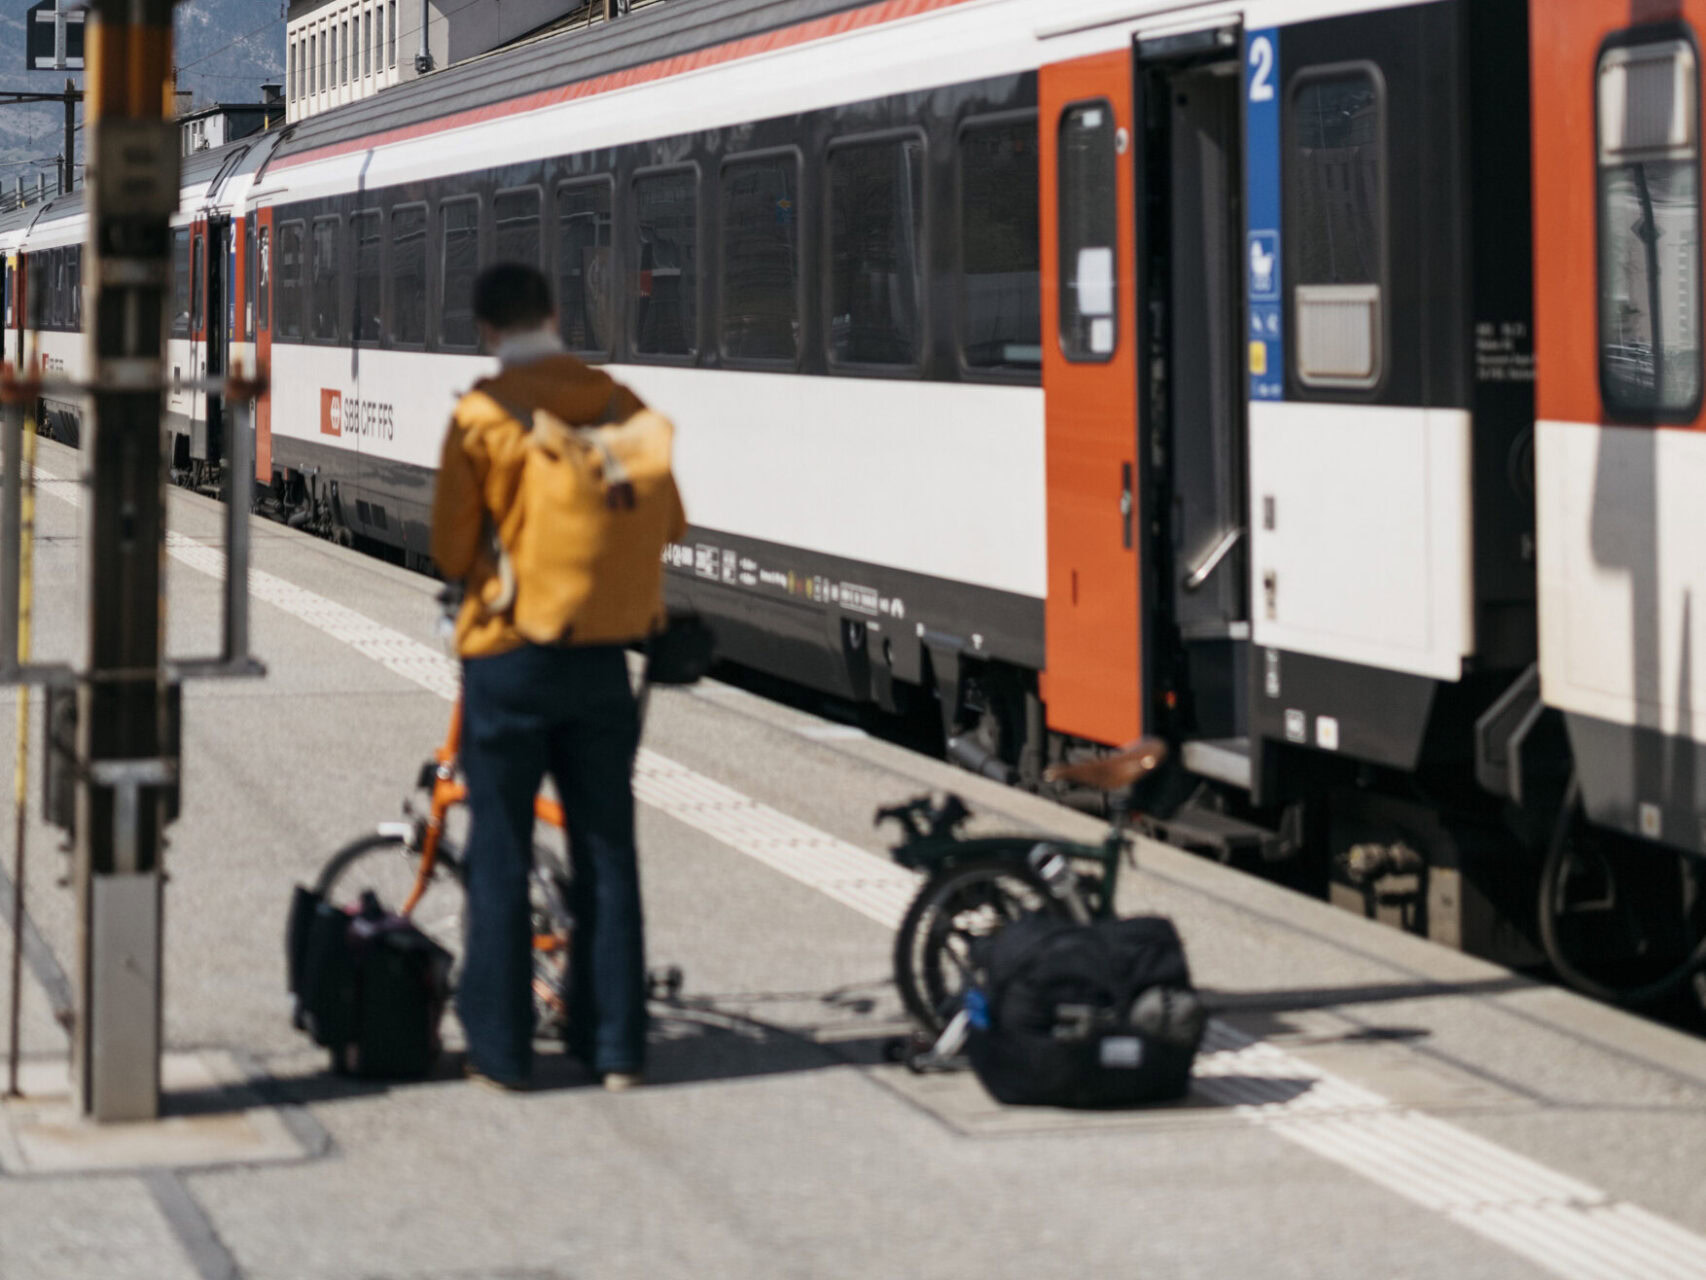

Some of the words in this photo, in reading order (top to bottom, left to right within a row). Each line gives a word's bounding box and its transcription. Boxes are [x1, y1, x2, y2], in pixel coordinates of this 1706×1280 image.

[1249, 36, 1273, 101] 2
[230, 223, 236, 253] 2
[344, 397, 359, 434] SBB
[361, 400, 376, 438] CFF
[378, 402, 393, 441] FFS
